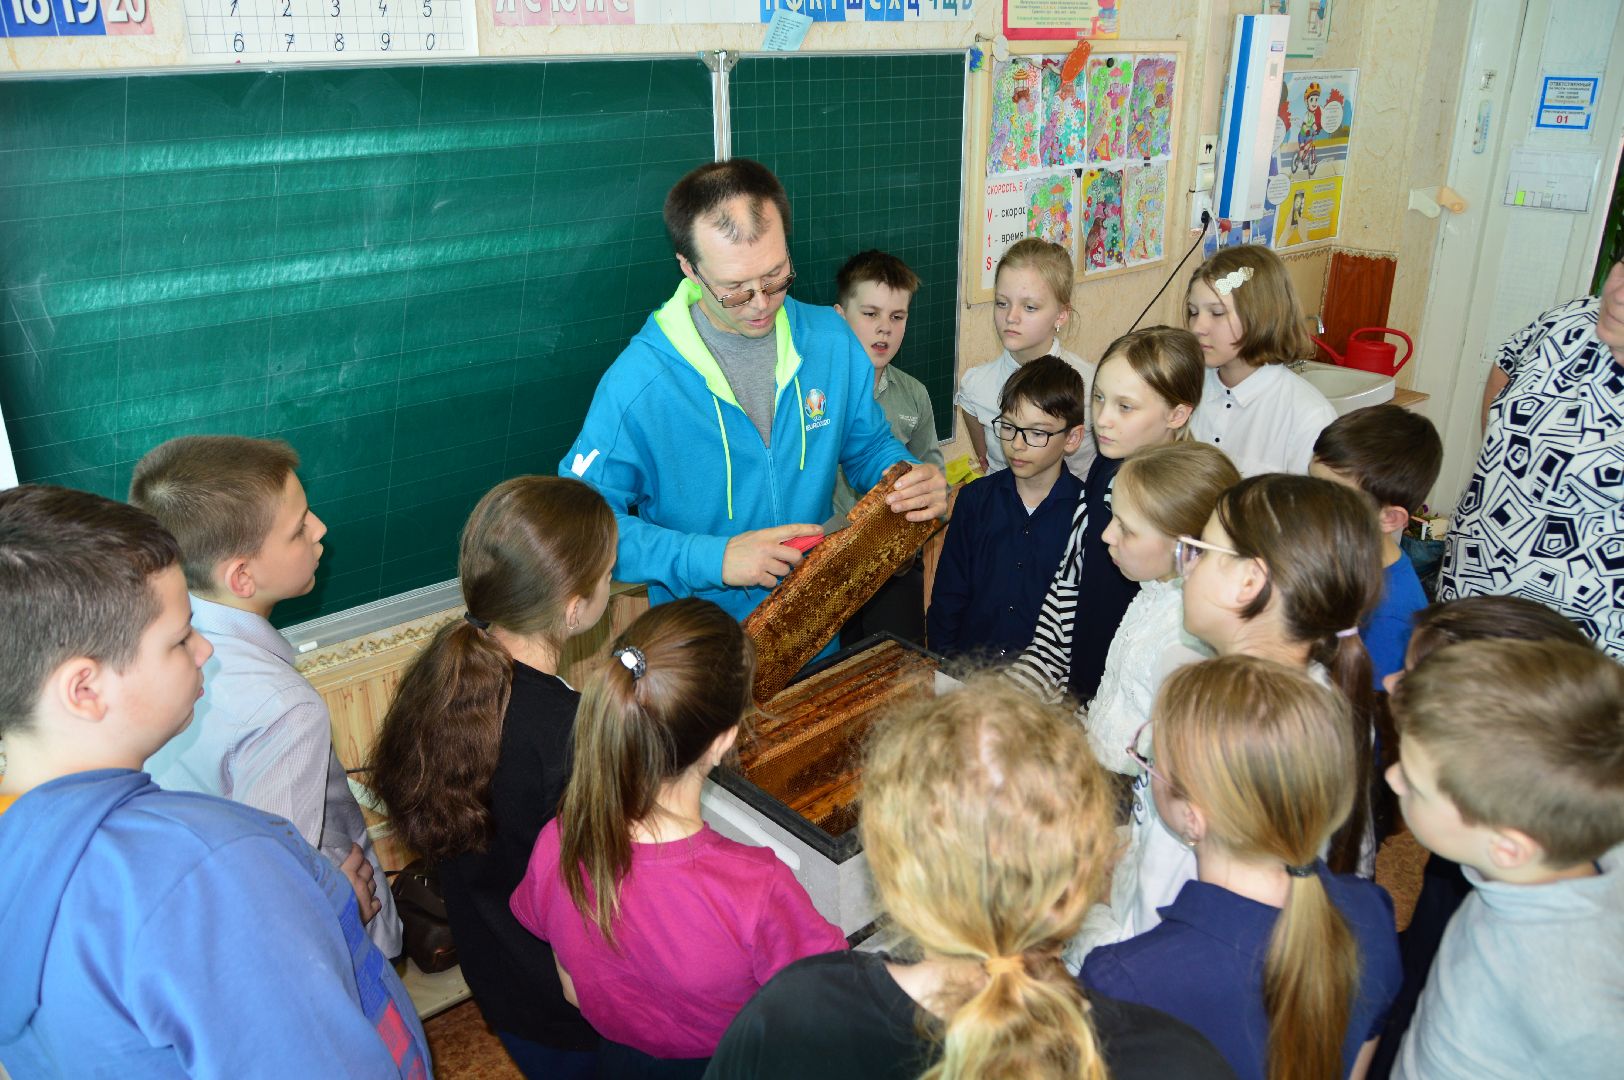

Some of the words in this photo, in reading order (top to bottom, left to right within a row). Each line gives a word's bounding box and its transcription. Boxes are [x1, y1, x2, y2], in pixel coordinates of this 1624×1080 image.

[330, 0, 341, 17] 3
[423, 0, 433, 17] 5
[233, 32, 245, 53] 6
[284, 33, 295, 52] 7
[334, 32, 345, 52] 8
[380, 32, 391, 51] 9
[426, 32, 435, 51] 0
[1556, 115, 1569, 124] 01
[1002, 231, 1024, 244] время
